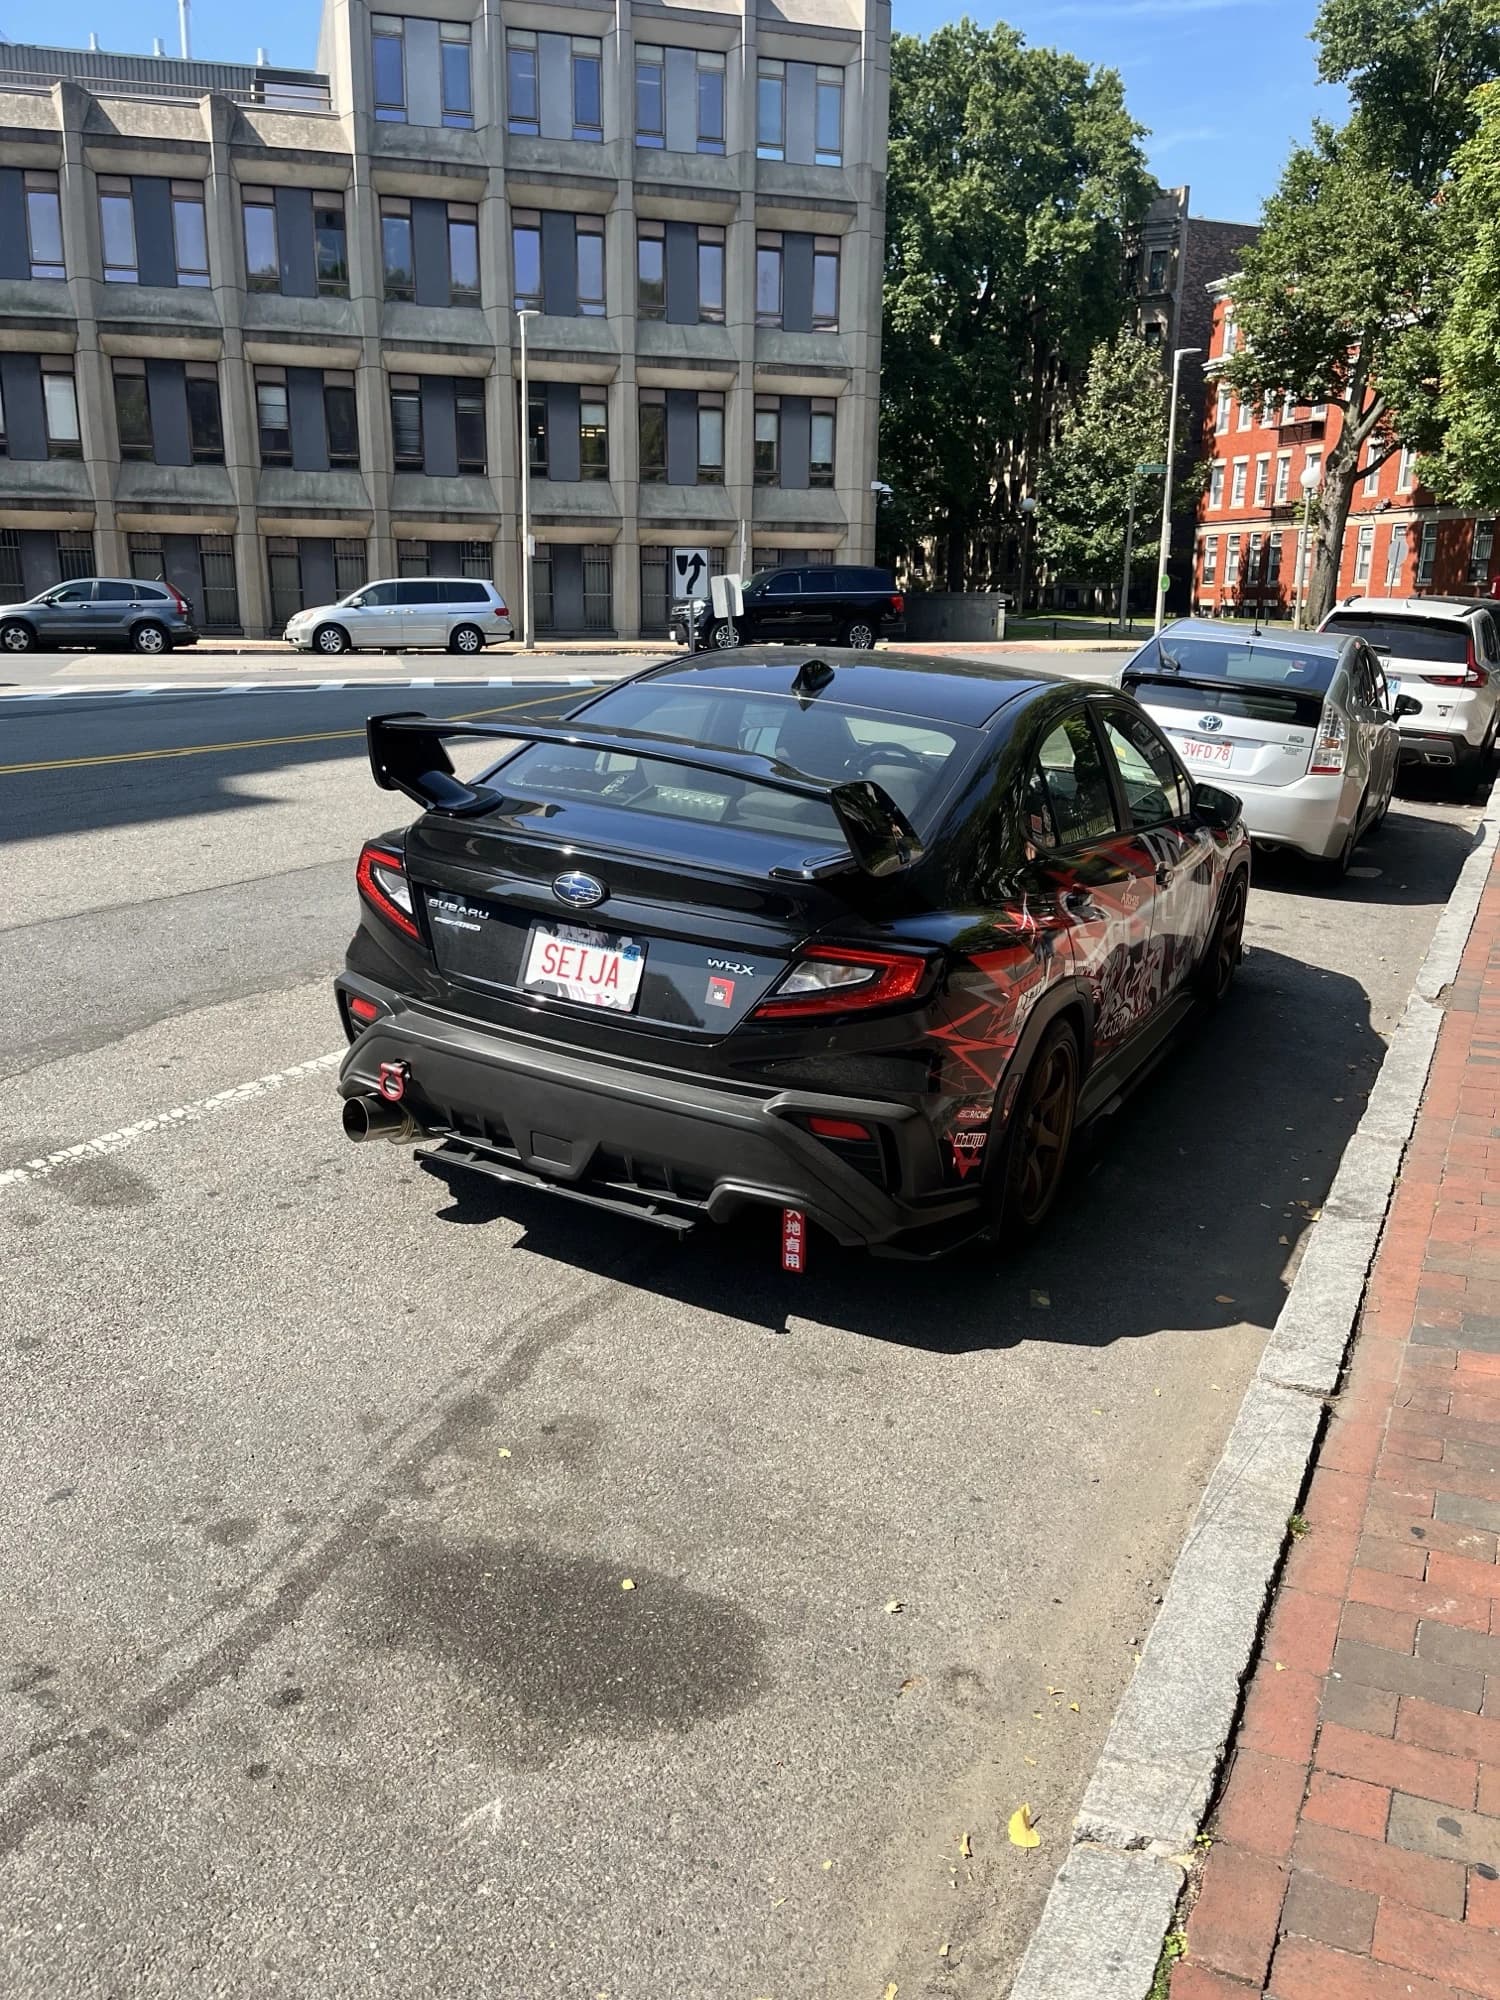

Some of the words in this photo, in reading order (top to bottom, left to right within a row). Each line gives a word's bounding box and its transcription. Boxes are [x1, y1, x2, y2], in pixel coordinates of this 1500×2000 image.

[1182, 741, 1212, 759] 3VFD
[1214, 746, 1231, 761] 78
[428, 898, 489, 919] SUBARU
[541, 943, 619, 989] SEIJA
[707, 958, 755, 976] WRX
